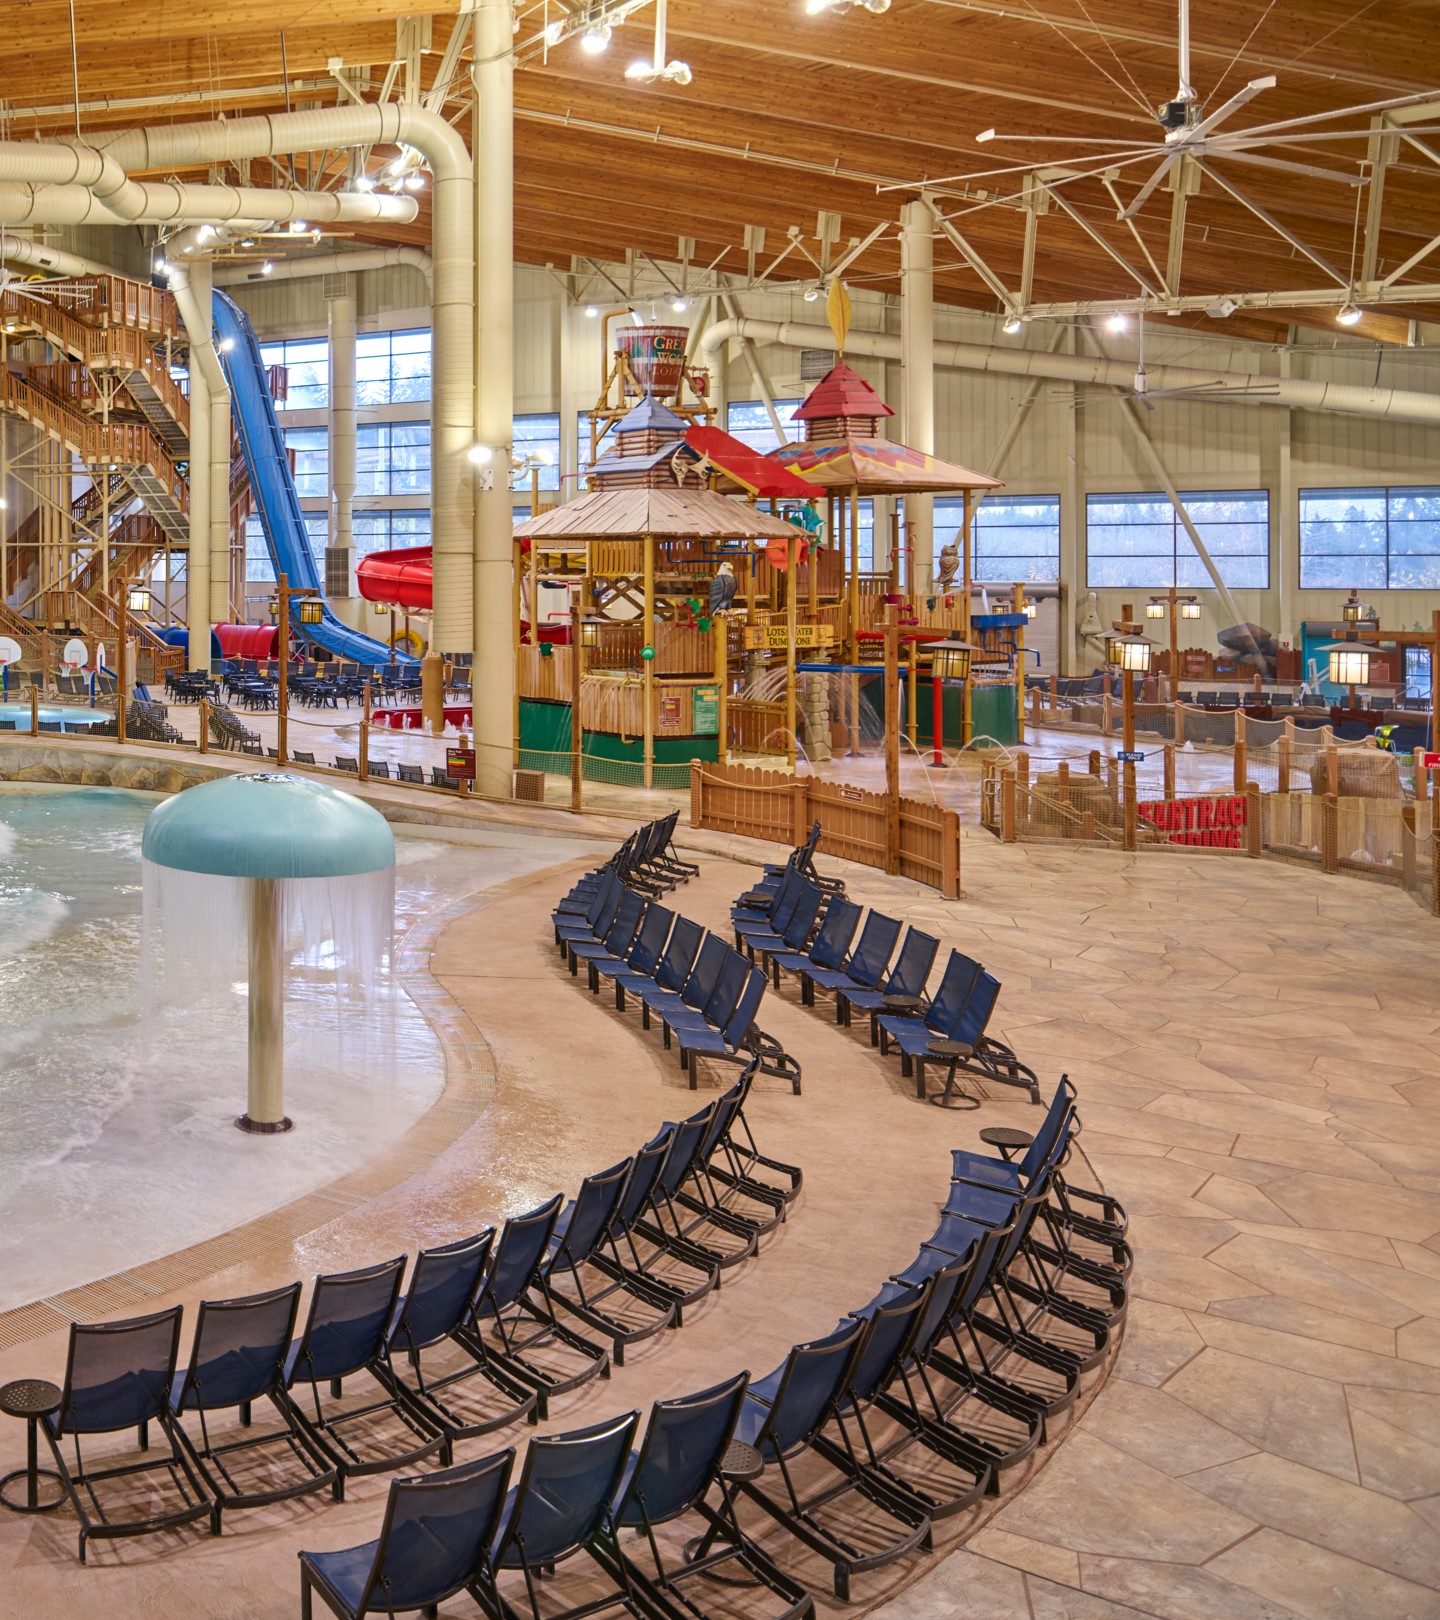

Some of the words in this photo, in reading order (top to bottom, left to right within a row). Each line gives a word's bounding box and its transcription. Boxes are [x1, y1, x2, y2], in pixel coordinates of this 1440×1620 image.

[654, 336, 685, 350] GREA
[766, 628, 788, 636] LOTS
[796, 628, 813, 636] ATER
[769, 637, 787, 646] DUM
[796, 637, 811, 645] ONE
